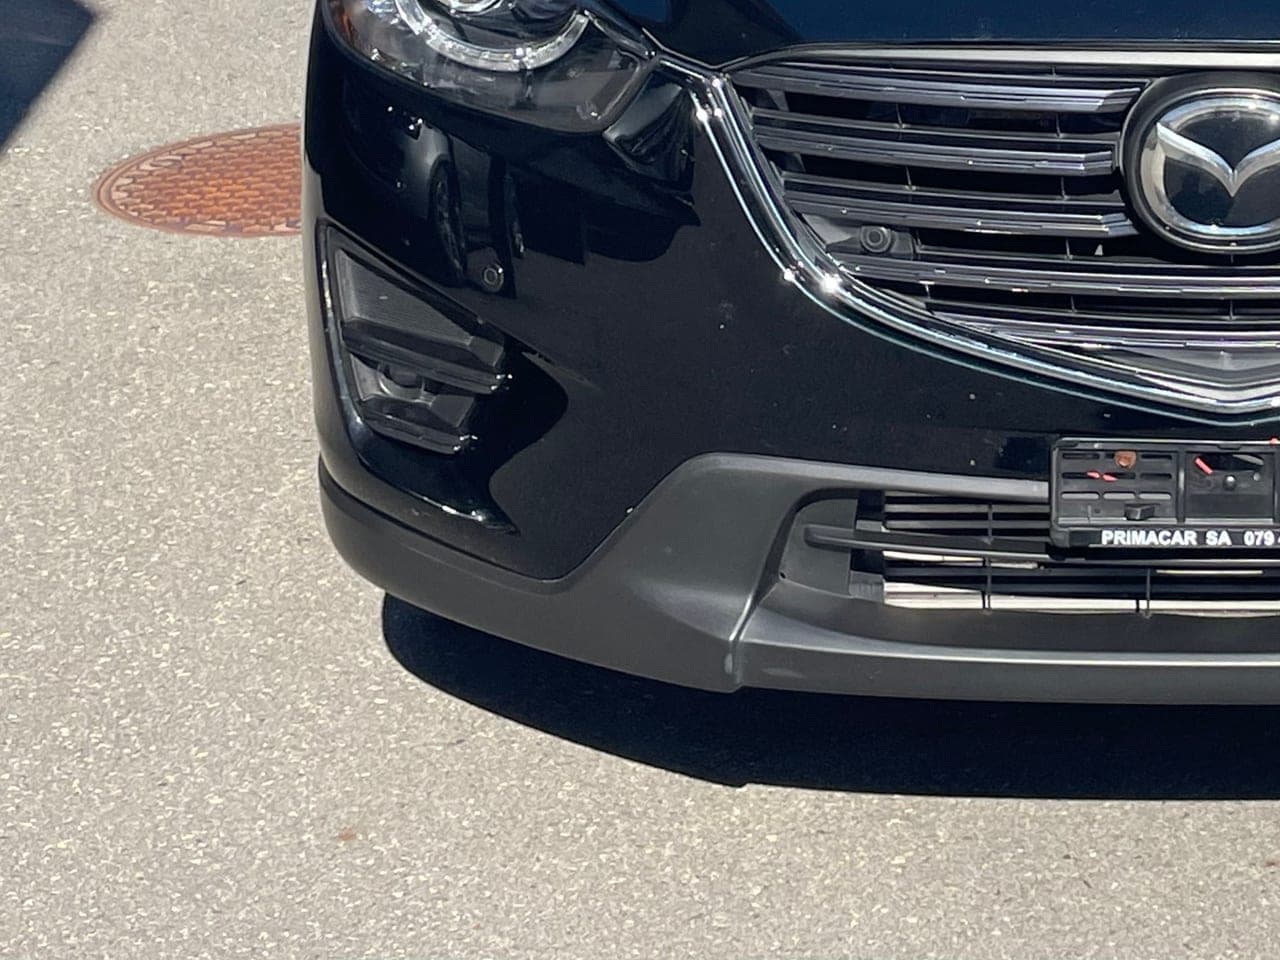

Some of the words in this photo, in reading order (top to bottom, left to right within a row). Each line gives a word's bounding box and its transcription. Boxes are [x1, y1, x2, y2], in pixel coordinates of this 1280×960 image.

[1101, 529, 1198, 545] PRIMACAR
[1205, 529, 1232, 545] SA
[1243, 530, 1275, 546] 079
